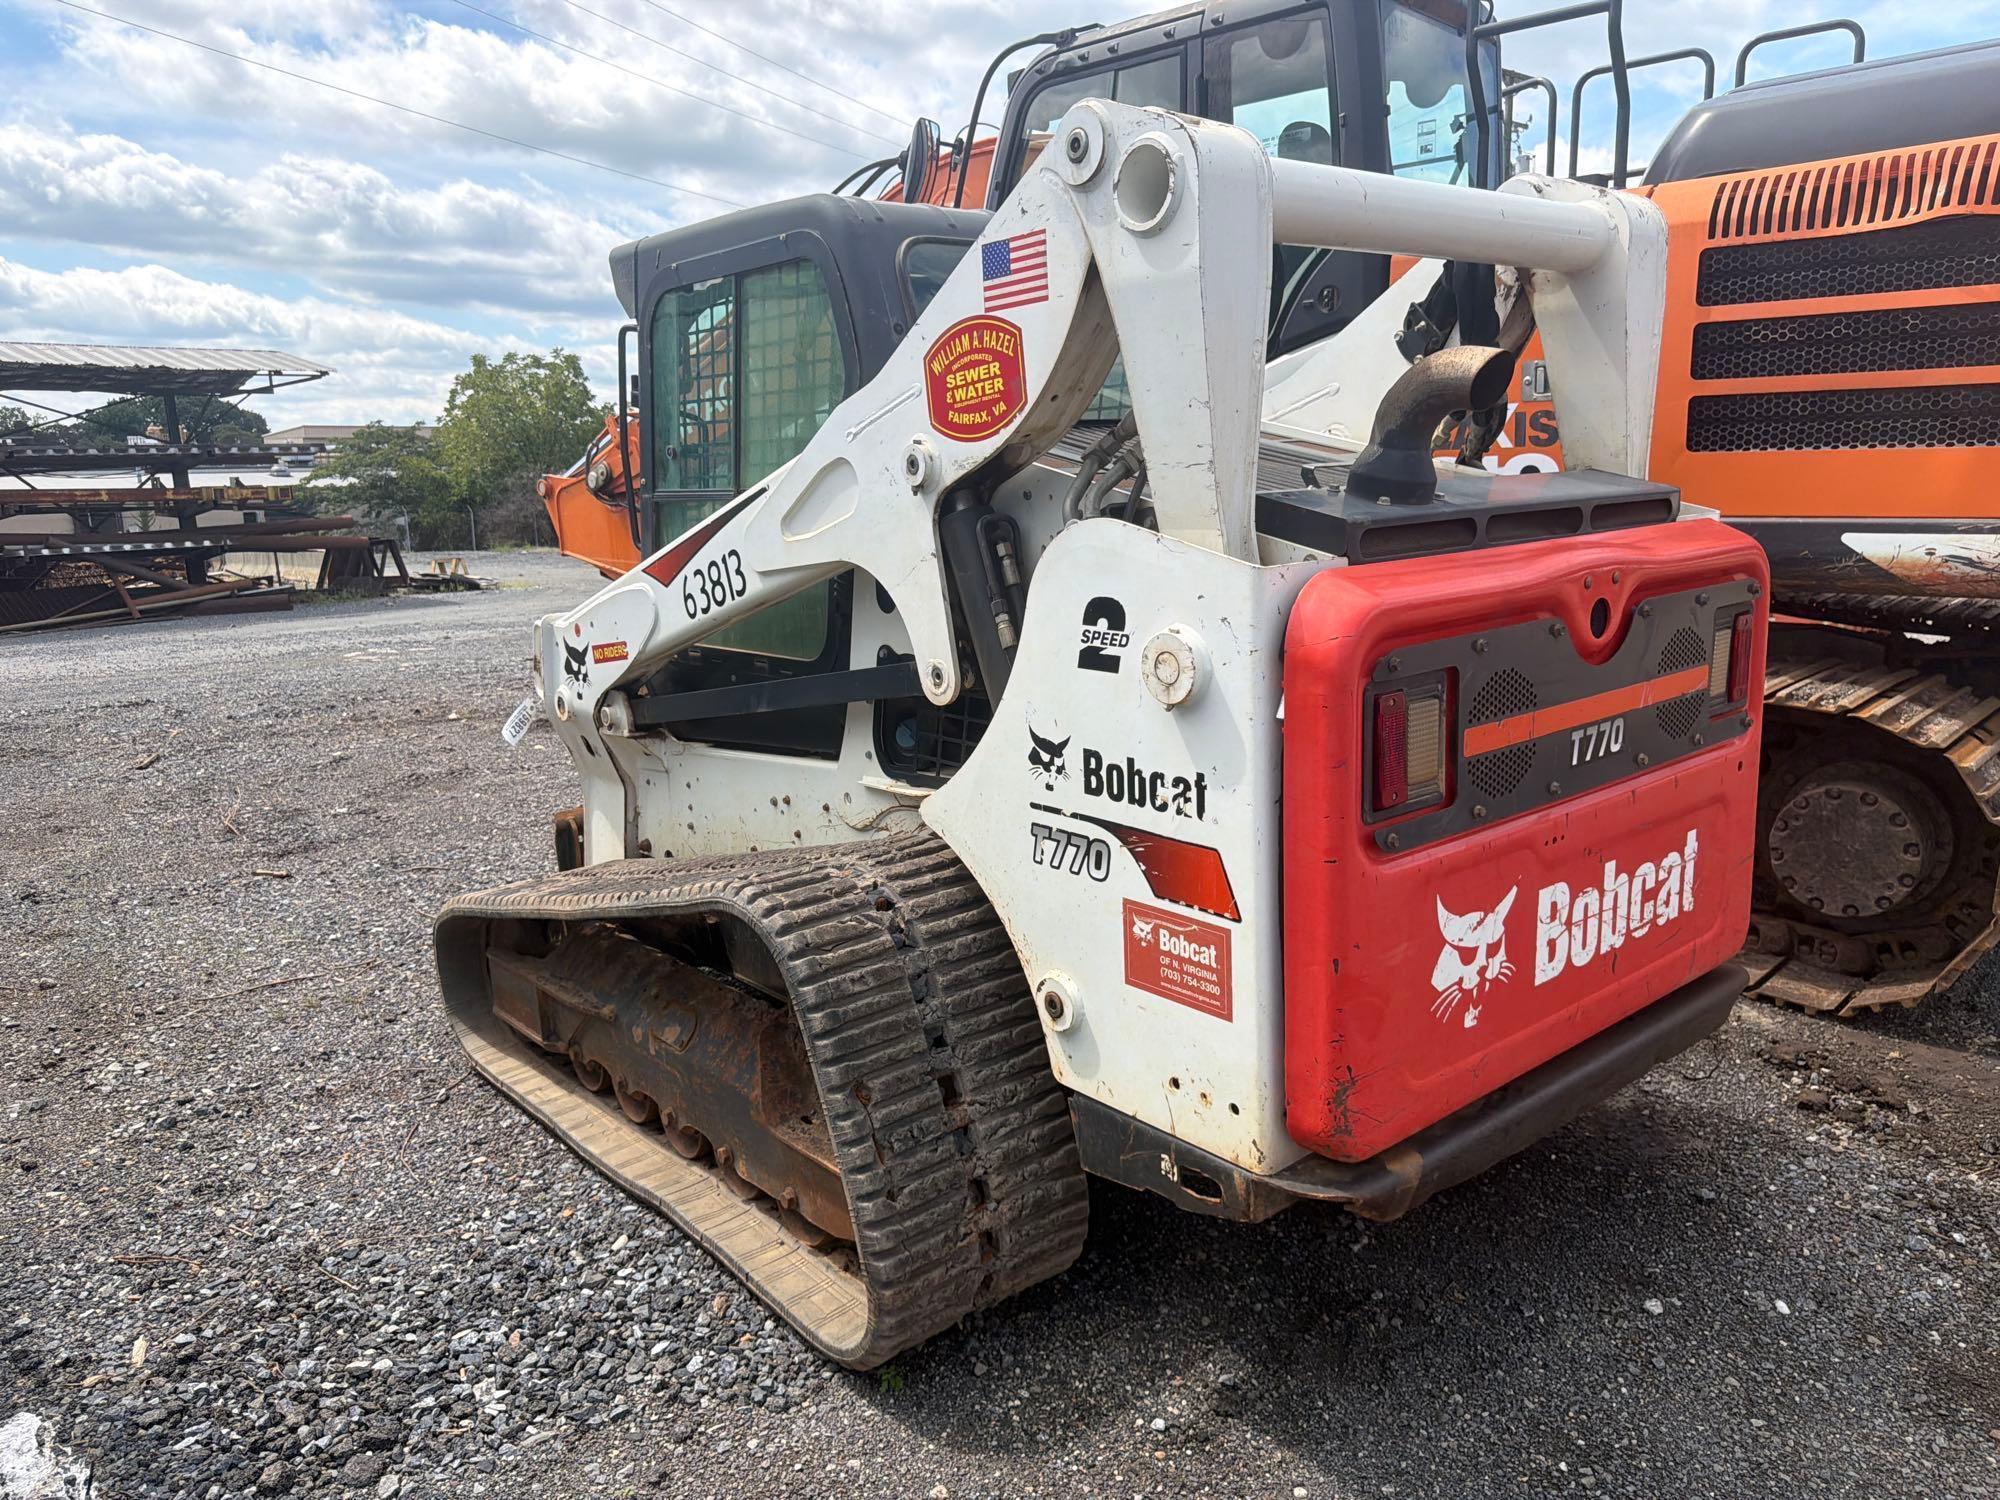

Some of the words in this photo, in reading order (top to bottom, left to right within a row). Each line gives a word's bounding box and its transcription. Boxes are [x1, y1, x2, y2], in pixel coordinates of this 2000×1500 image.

[931, 333, 970, 376] WILLIAM
[972, 330, 982, 349] A.
[983, 329, 1014, 357] HAZEL
[951, 353, 993, 372] INCORPORATED
[946, 362, 1001, 388] SEWER
[946, 390, 953, 404] &
[954, 377, 1004, 402] WATER
[948, 410, 991, 424] FAIRFAX,
[992, 400, 1007, 416] VA
[683, 549, 747, 619] 63813
[594, 648, 604, 660] NO
[603, 644, 627, 658] RIDERS
[1077, 596, 1126, 674] 2
[1080, 629, 1130, 648] SPEED
[1570, 718, 1625, 767] T770
[1083, 748, 1208, 821] Bobcat
[1031, 822, 1111, 882] T770
[1534, 828, 1699, 987] Bobcat
[1159, 928, 1217, 968] Bobcat
[1160, 956, 1171, 965] OF
[1172, 960, 1181, 969] N.
[1182, 963, 1218, 982] VIRGINIA
[1160, 967, 1181, 983] (703)
[1182, 975, 1221, 996] 754-3300
